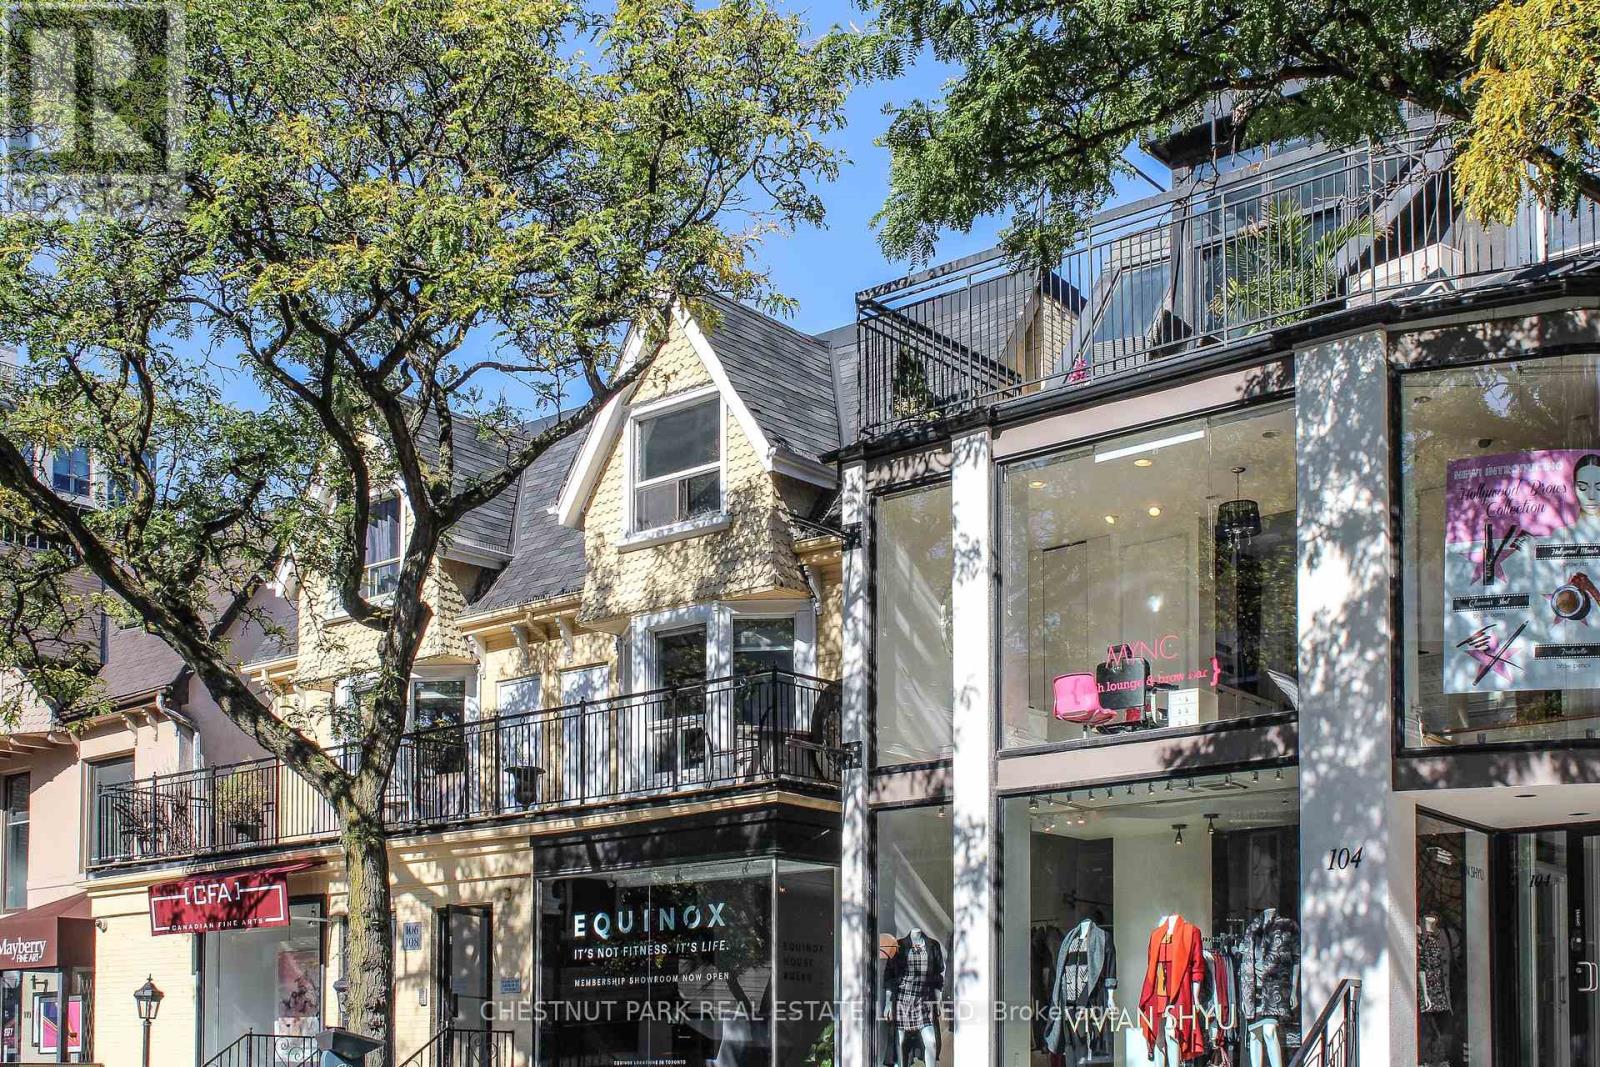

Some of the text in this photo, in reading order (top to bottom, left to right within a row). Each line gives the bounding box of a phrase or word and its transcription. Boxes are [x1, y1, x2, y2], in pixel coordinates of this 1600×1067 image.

[1487, 499, 1545, 517] Collection
[1327, 846, 1363, 870] 104
[171, 918, 263, 931] CANADIAN FINE ARTS
[574, 902, 726, 939] EQUINOX
[405, 937, 420, 948] 108
[574, 940, 730, 960] IT'S NOT FITNESS. IT'S LIFE.
[16, 953, 29, 963] FINE
[574, 972, 730, 988] MEMBERSHIP SHOWROOM NOW OPEN
[1065, 1004, 1236, 1033] VIVIAN SHYU
